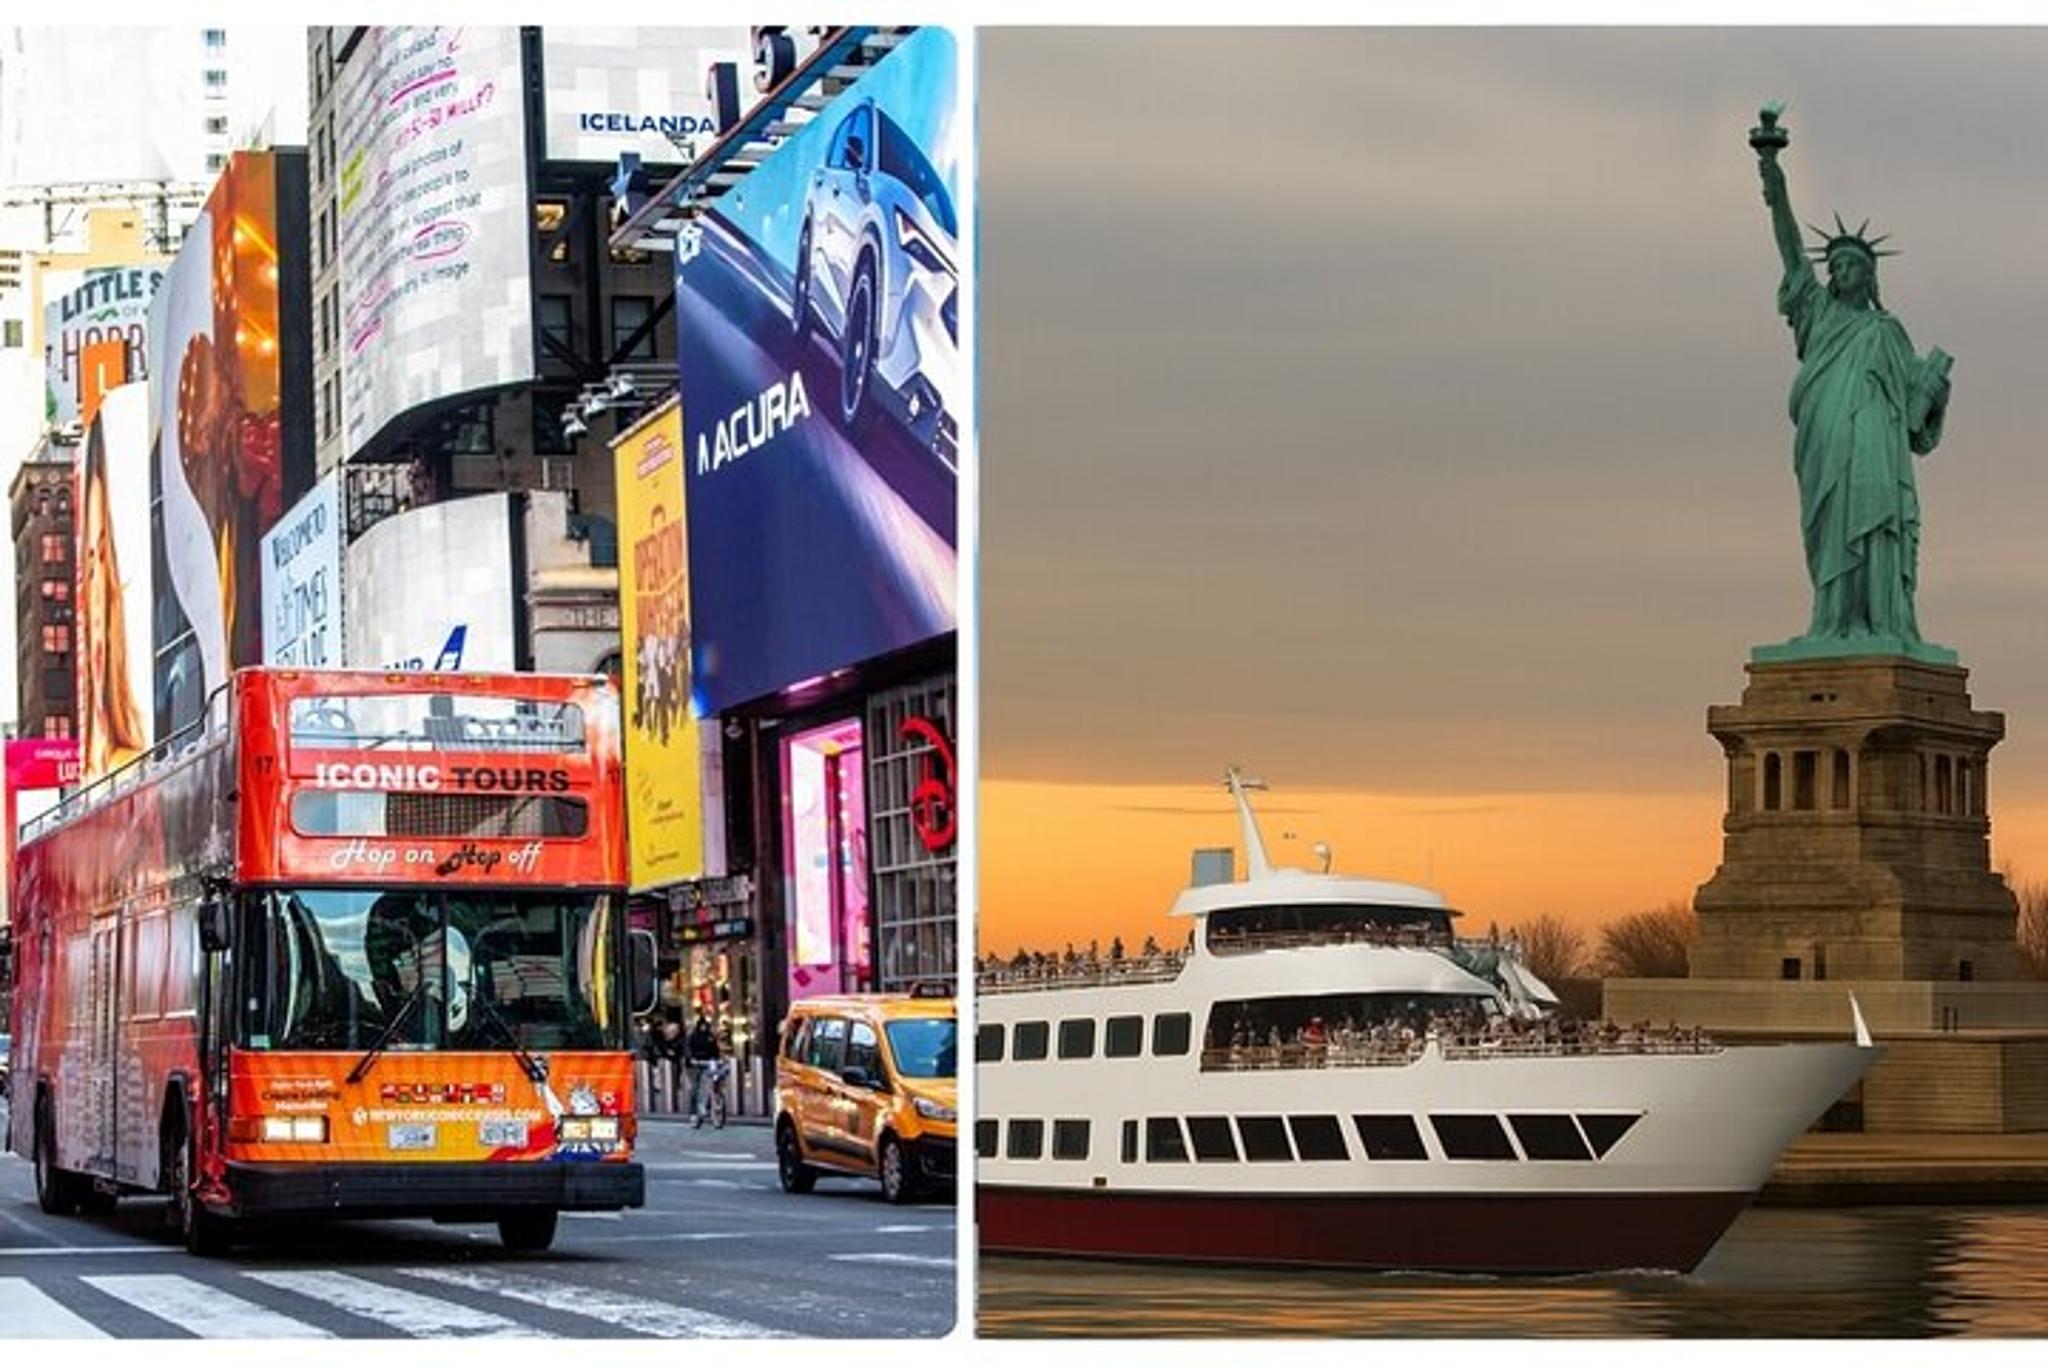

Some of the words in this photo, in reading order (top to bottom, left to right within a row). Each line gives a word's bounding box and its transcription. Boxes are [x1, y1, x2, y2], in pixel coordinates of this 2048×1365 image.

[62, 270, 144, 323] LITTLE
[713, 370, 811, 471] ACURA
[314, 763, 441, 790] ICONIC
[450, 767, 570, 792] TOURS
[330, 839, 397, 874] Hop
[404, 850, 435, 865] on
[435, 844, 501, 876] Hop
[508, 841, 543, 873] off
